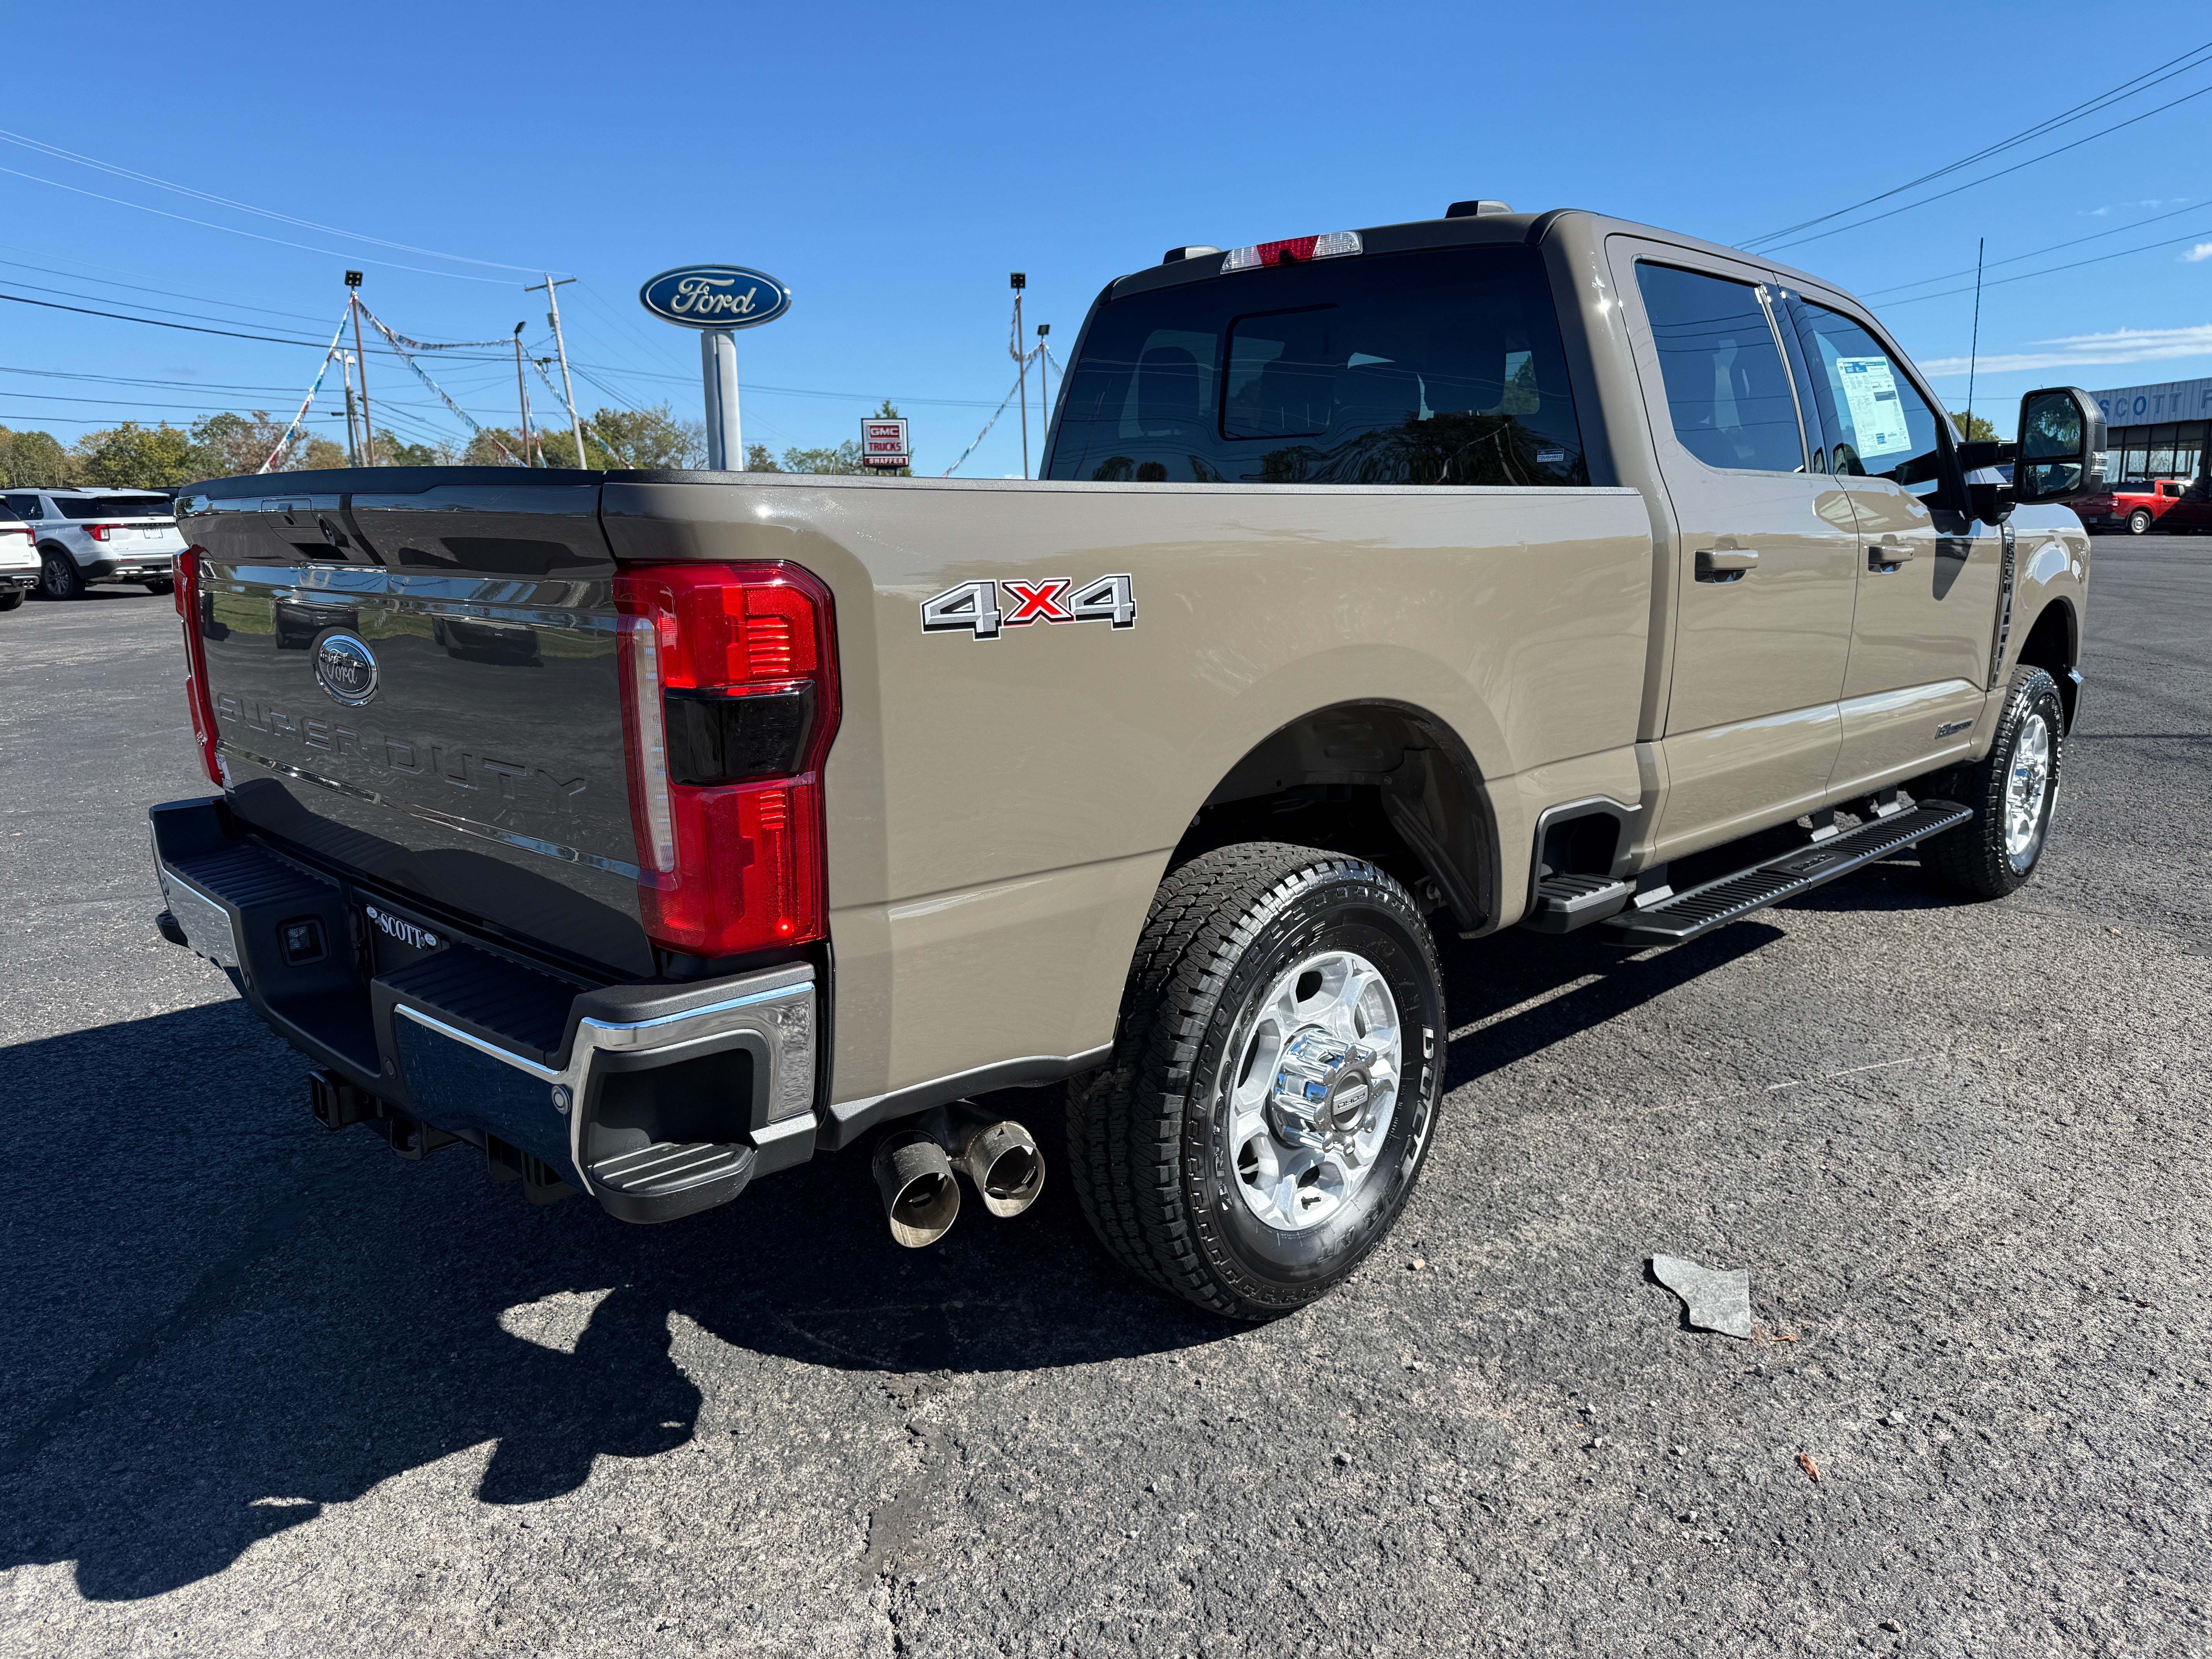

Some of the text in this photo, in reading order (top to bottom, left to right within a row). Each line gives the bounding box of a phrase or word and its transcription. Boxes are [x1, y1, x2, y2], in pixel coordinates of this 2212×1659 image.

[670, 276, 757, 314] Ford
[2098, 392, 2181, 417] SCOTT
[869, 442, 902, 452] TRUCKS
[871, 428, 899, 436] GMC
[326, 648, 357, 684] Ford
[217, 692, 586, 814] SUPER DUTY
[381, 913, 422, 949] SCOTT
[1338, 1092, 1365, 1109] FORD
